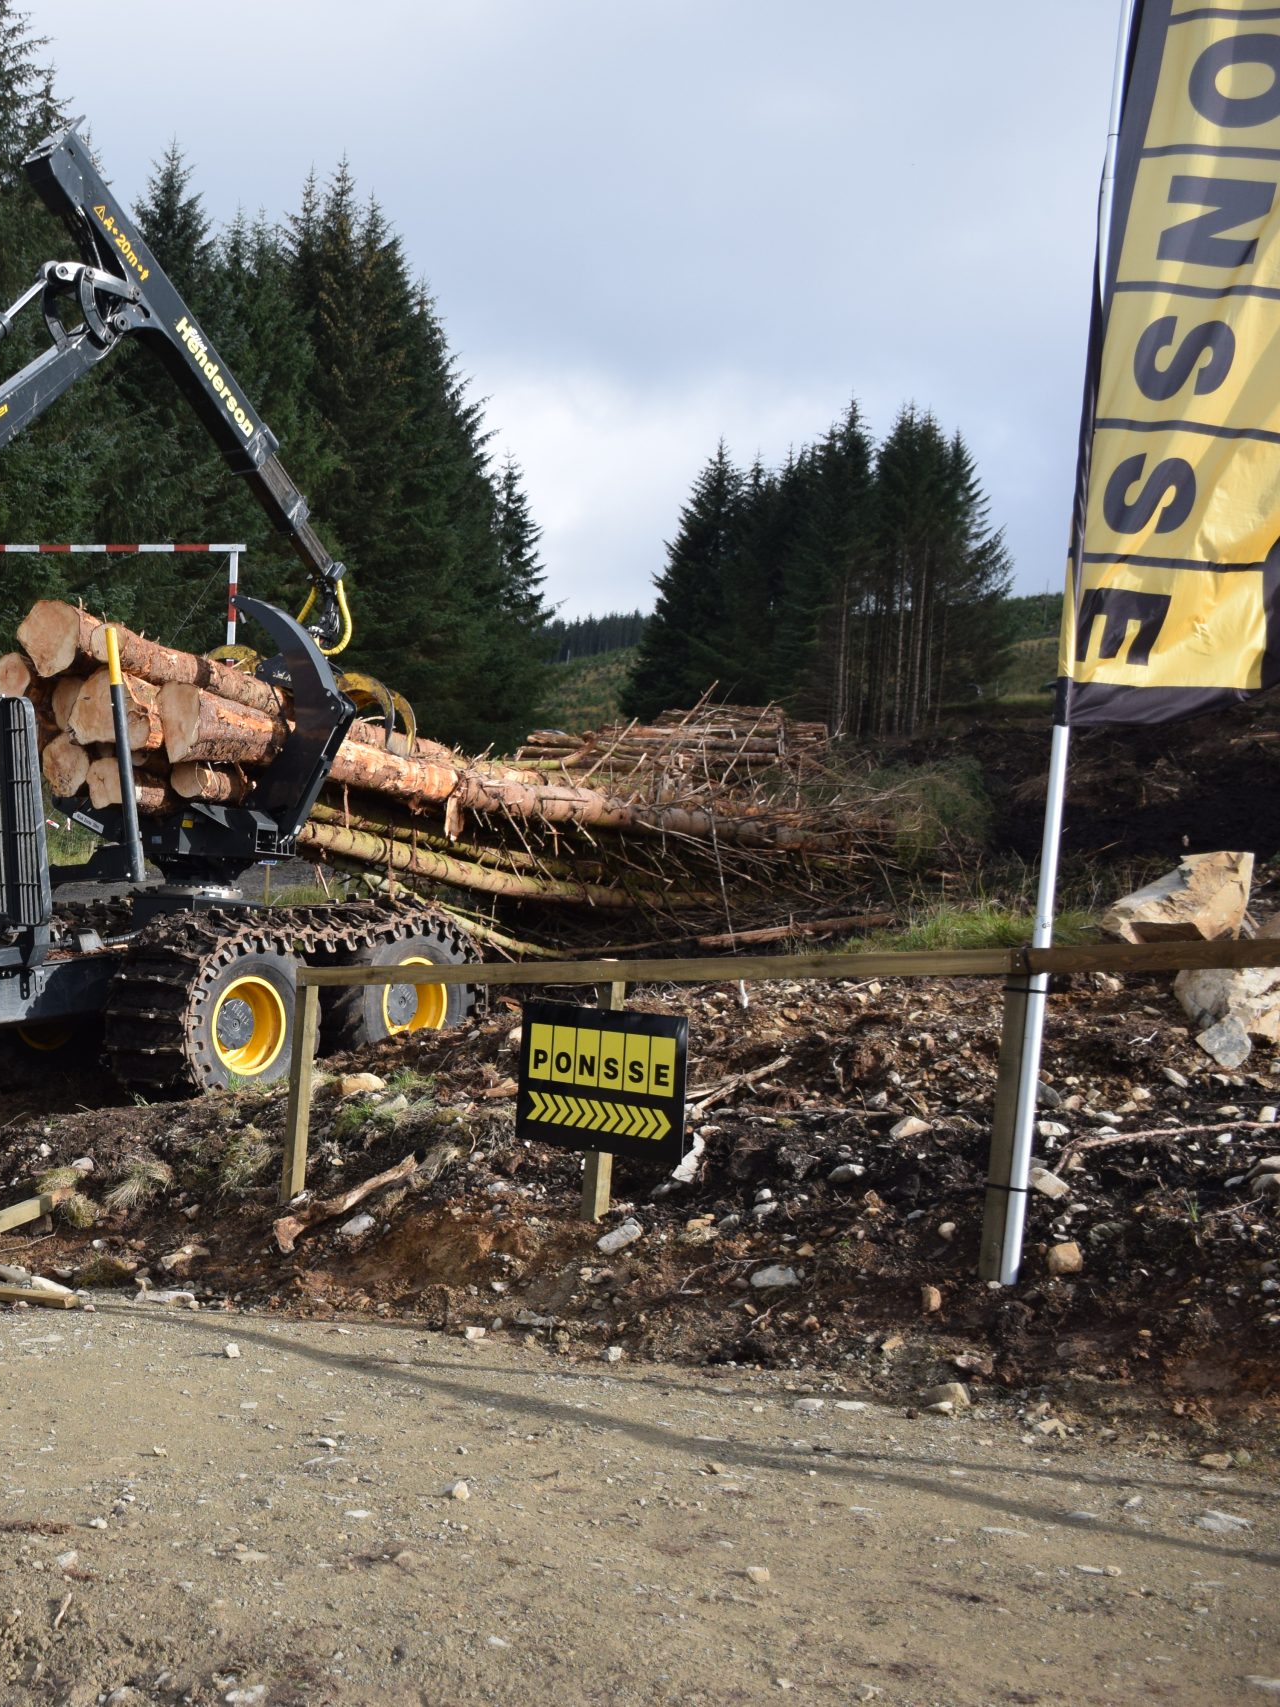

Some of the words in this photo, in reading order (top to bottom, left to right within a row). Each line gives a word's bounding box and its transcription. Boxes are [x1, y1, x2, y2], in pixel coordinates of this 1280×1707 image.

[114, 232, 139, 268] 20m
[175, 316, 254, 437] Henderson
[533, 1049, 670, 1087] PONSSE
